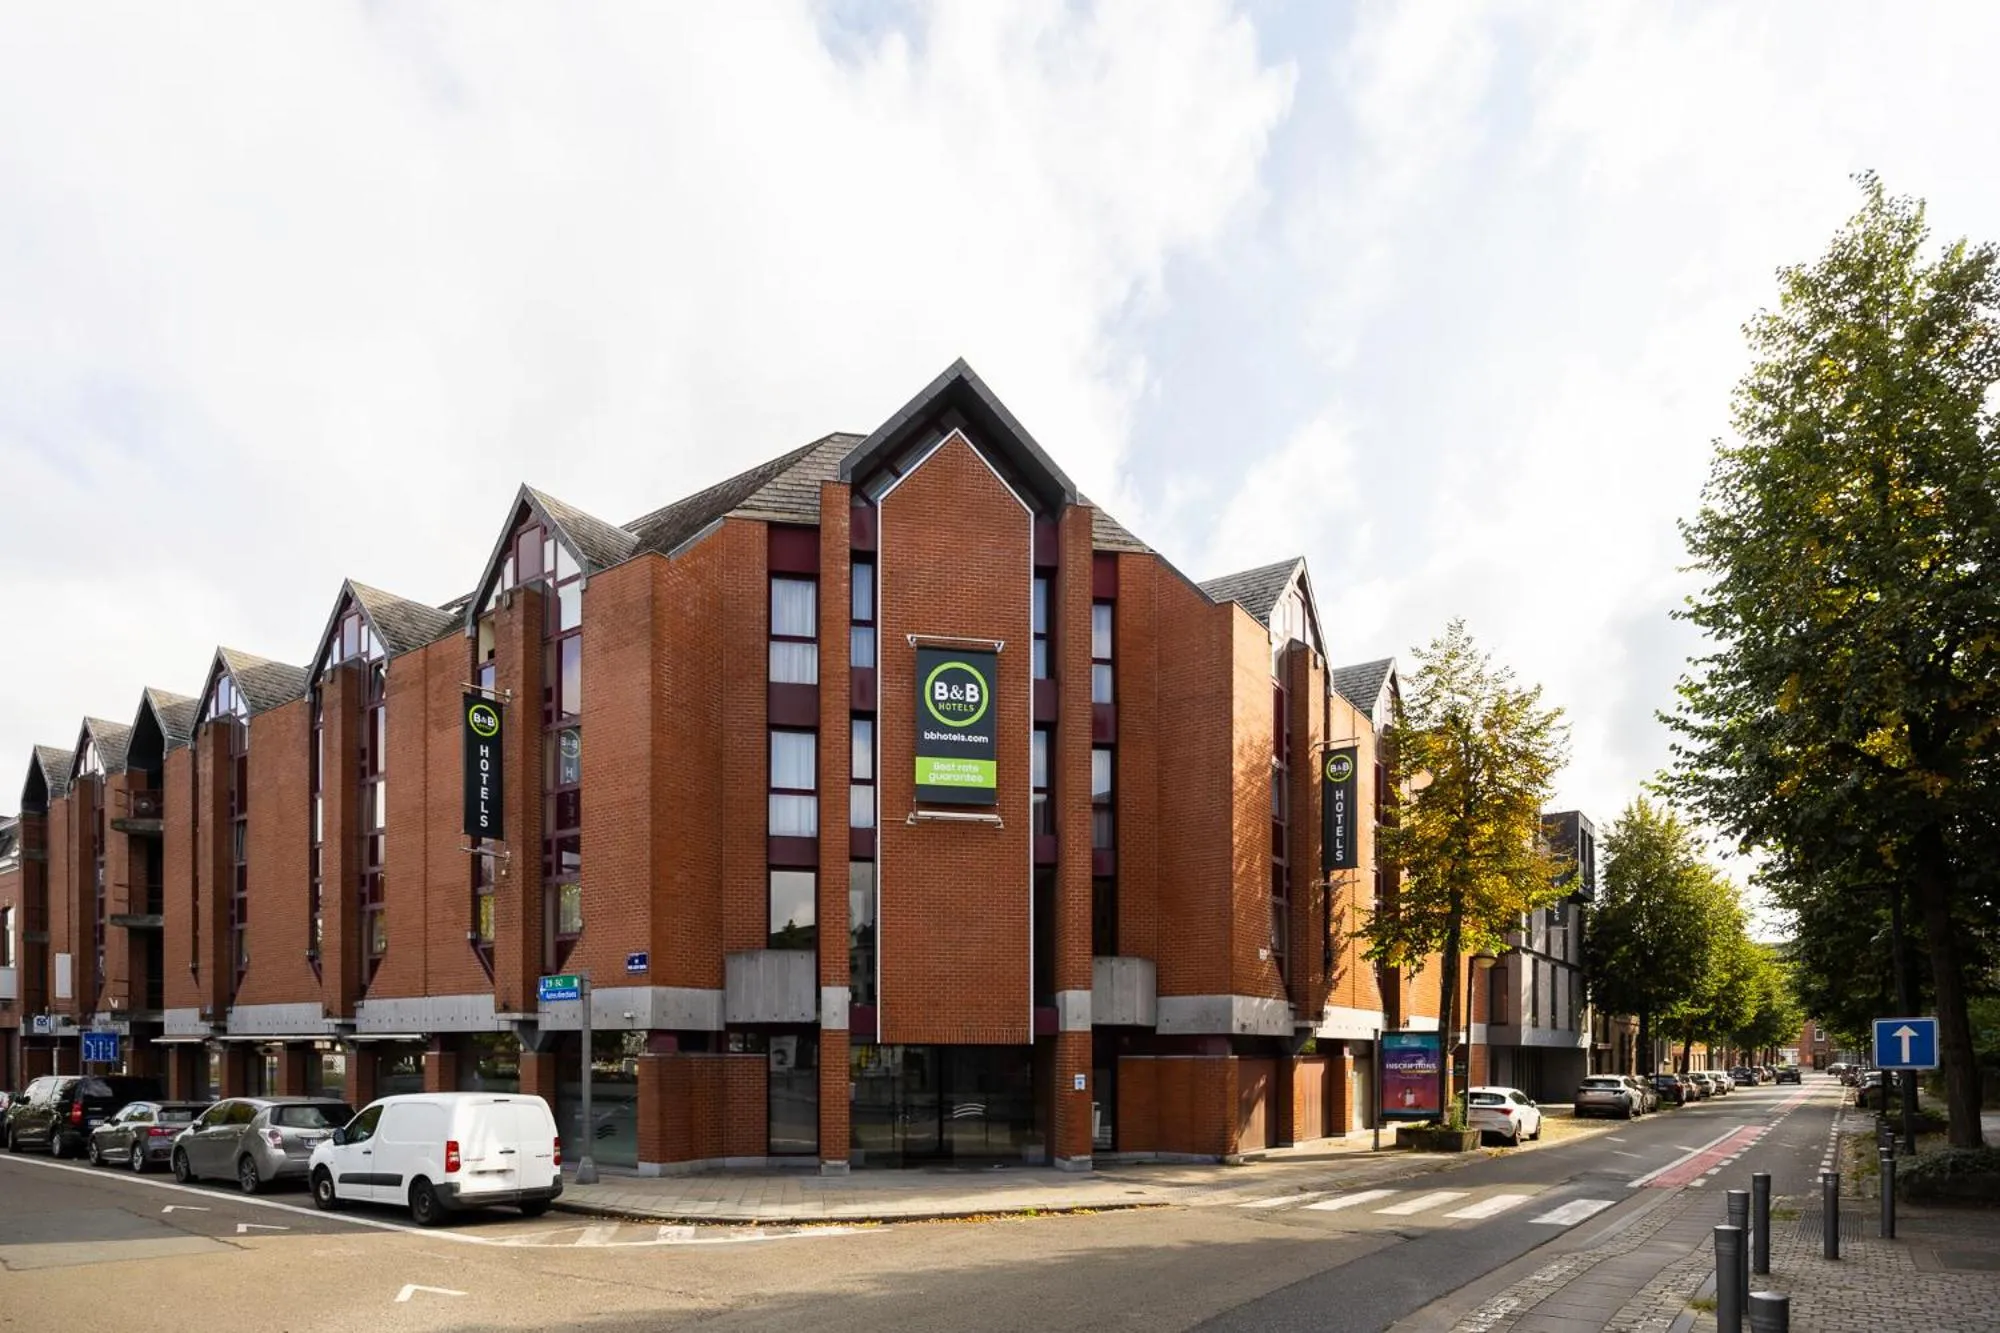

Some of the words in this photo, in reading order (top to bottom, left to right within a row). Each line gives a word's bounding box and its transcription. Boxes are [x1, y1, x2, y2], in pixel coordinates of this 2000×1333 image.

[934, 681, 980, 703] B&B
[938, 703, 975, 712] HOTELS
[473, 712, 495, 727] B&B
[923, 731, 989, 744] bbhotels.com
[479, 744, 489, 828] HOTELS
[1335, 789, 1344, 862] HOTELS
